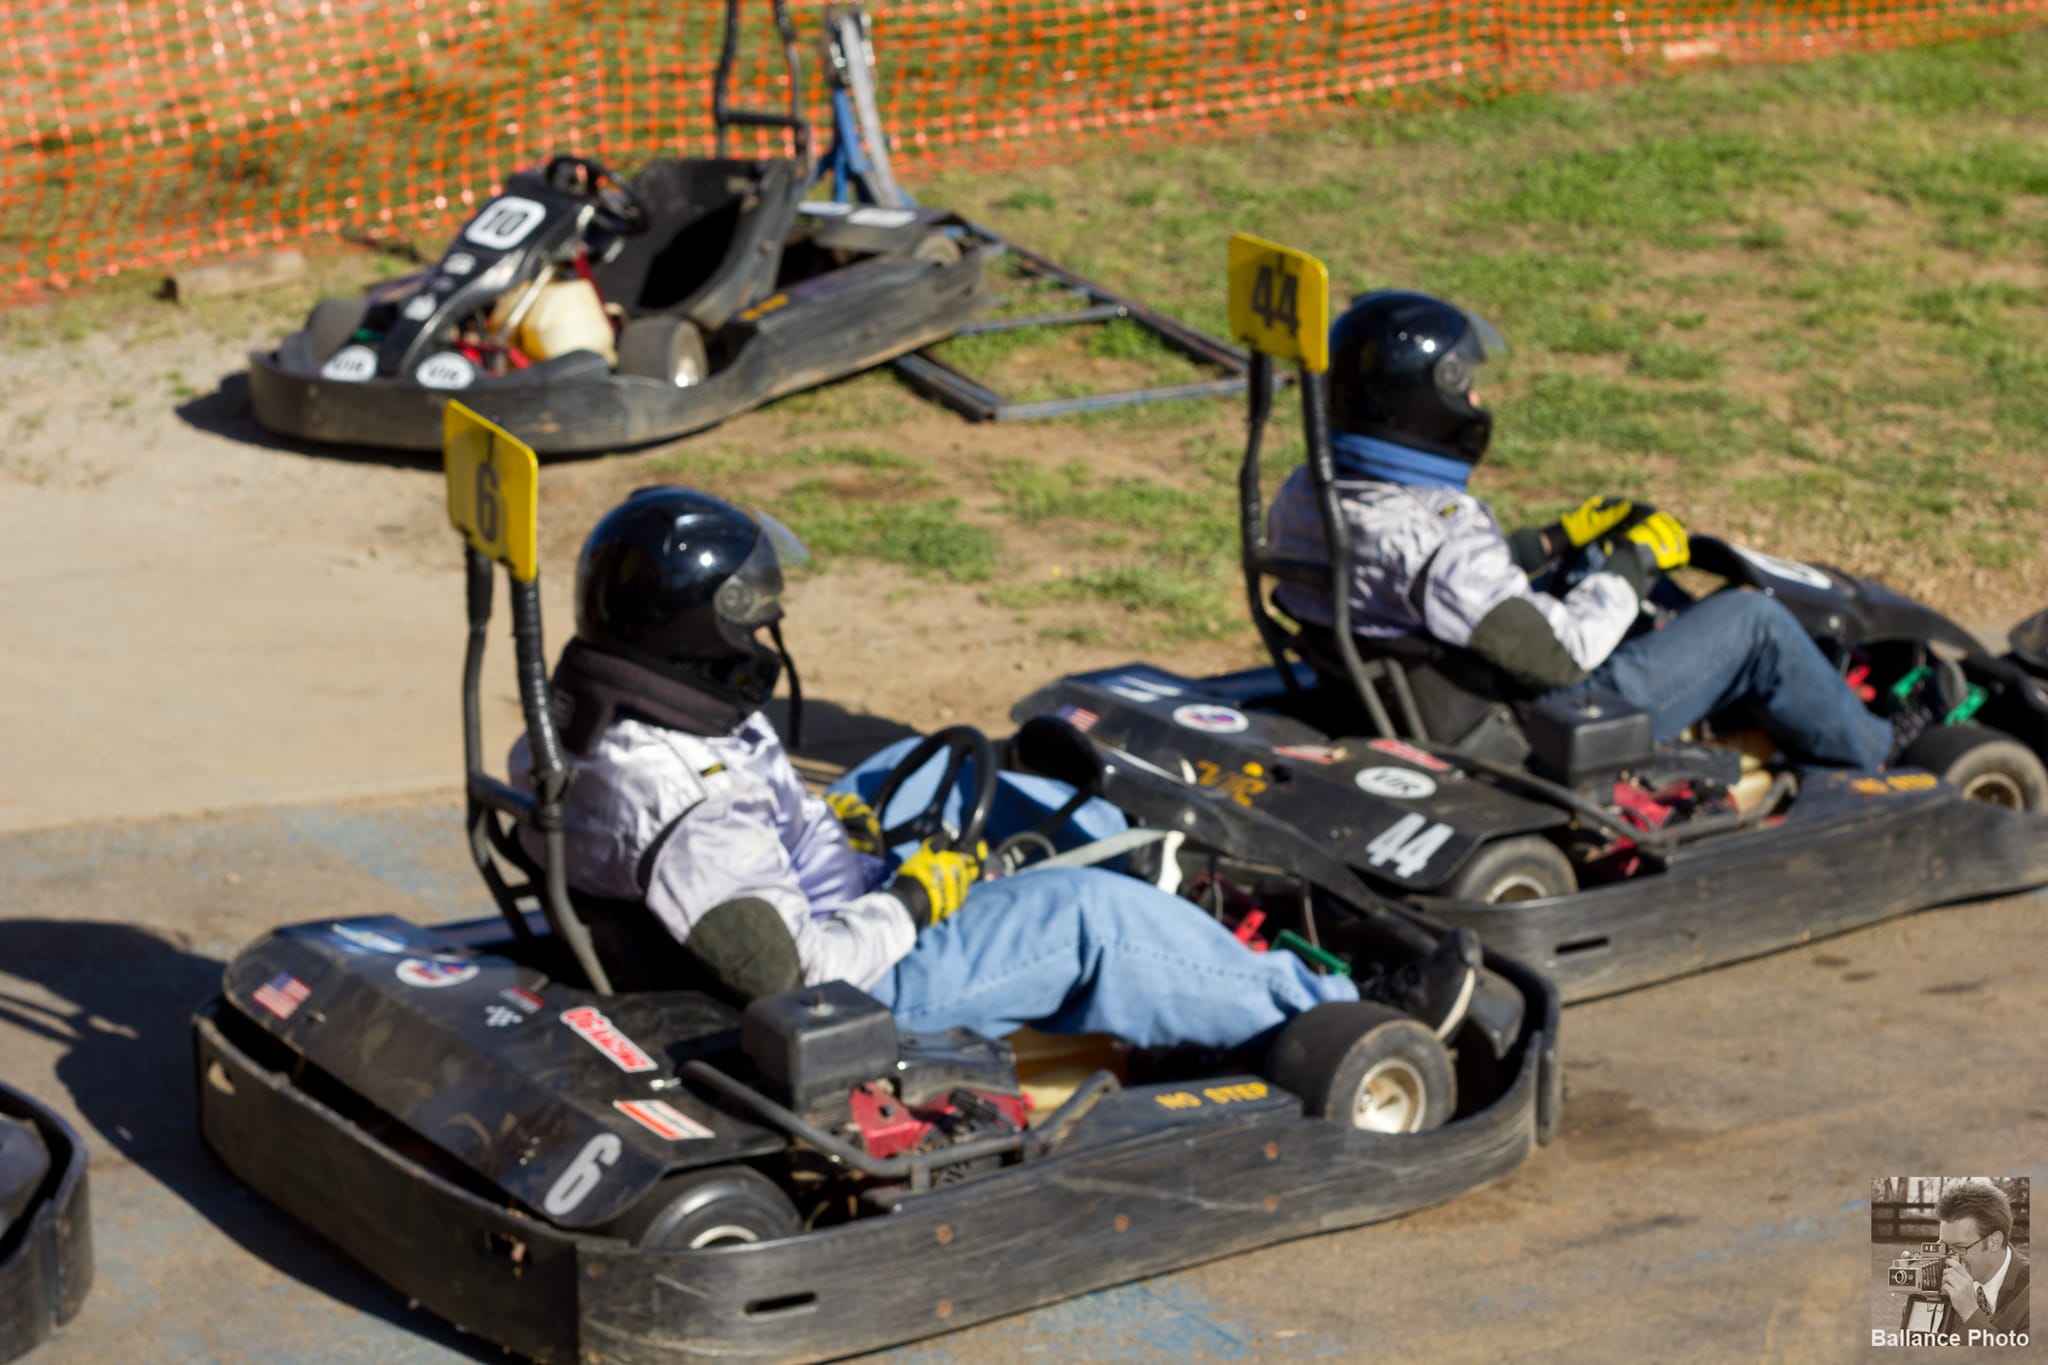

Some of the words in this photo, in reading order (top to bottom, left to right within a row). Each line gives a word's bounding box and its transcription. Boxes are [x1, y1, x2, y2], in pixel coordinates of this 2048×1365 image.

[480, 208, 529, 236] 10
[1252, 265, 1300, 336] 44
[476, 461, 498, 543] 6
[1366, 812, 1455, 878] 44
[544, 1132, 622, 1216] 6
